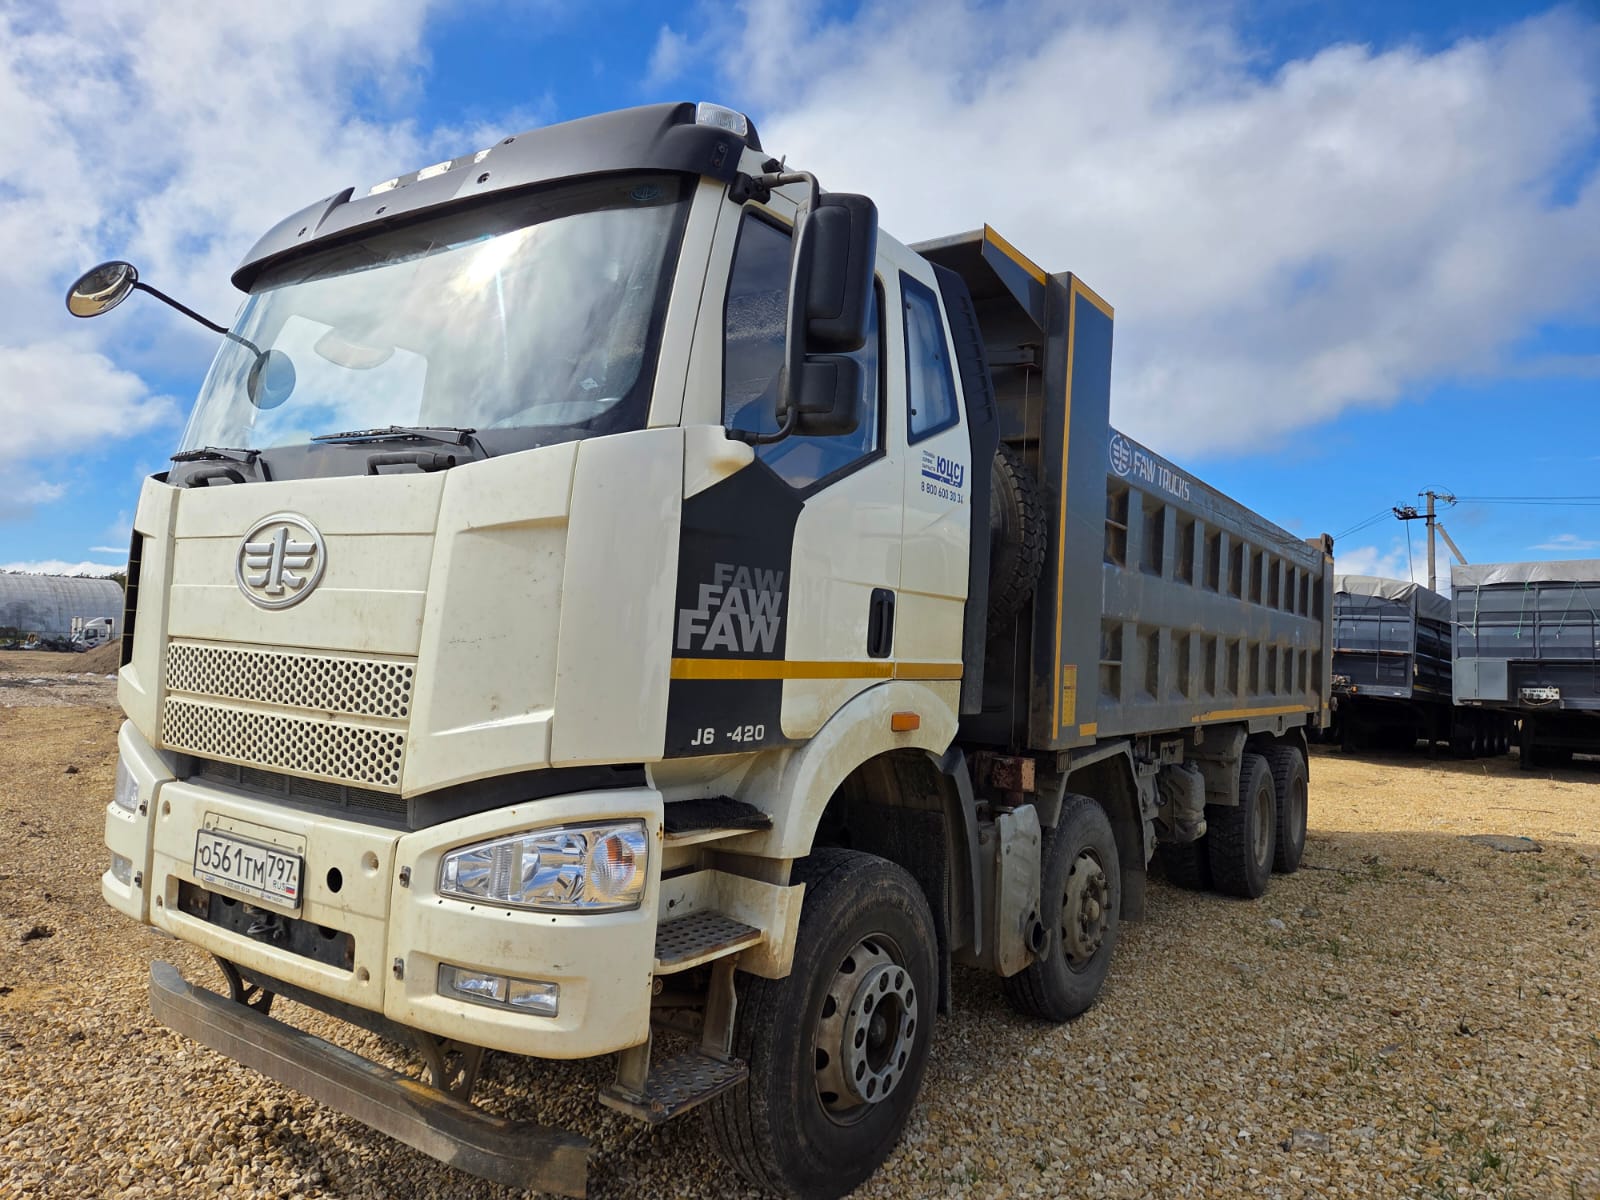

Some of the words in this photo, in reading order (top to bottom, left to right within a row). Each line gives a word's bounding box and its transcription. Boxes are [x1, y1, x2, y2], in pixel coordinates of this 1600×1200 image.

[1133, 451, 1156, 484] FAW
[1158, 466, 1190, 501] TRUCKS
[714, 562, 784, 597] FAW
[697, 583, 783, 622] FAW
[677, 608, 782, 653] FAW
[690, 727, 715, 746] J6
[726, 724, 765, 743] -420
[267, 854, 295, 883] 797
[272, 881, 286, 891] RUS
